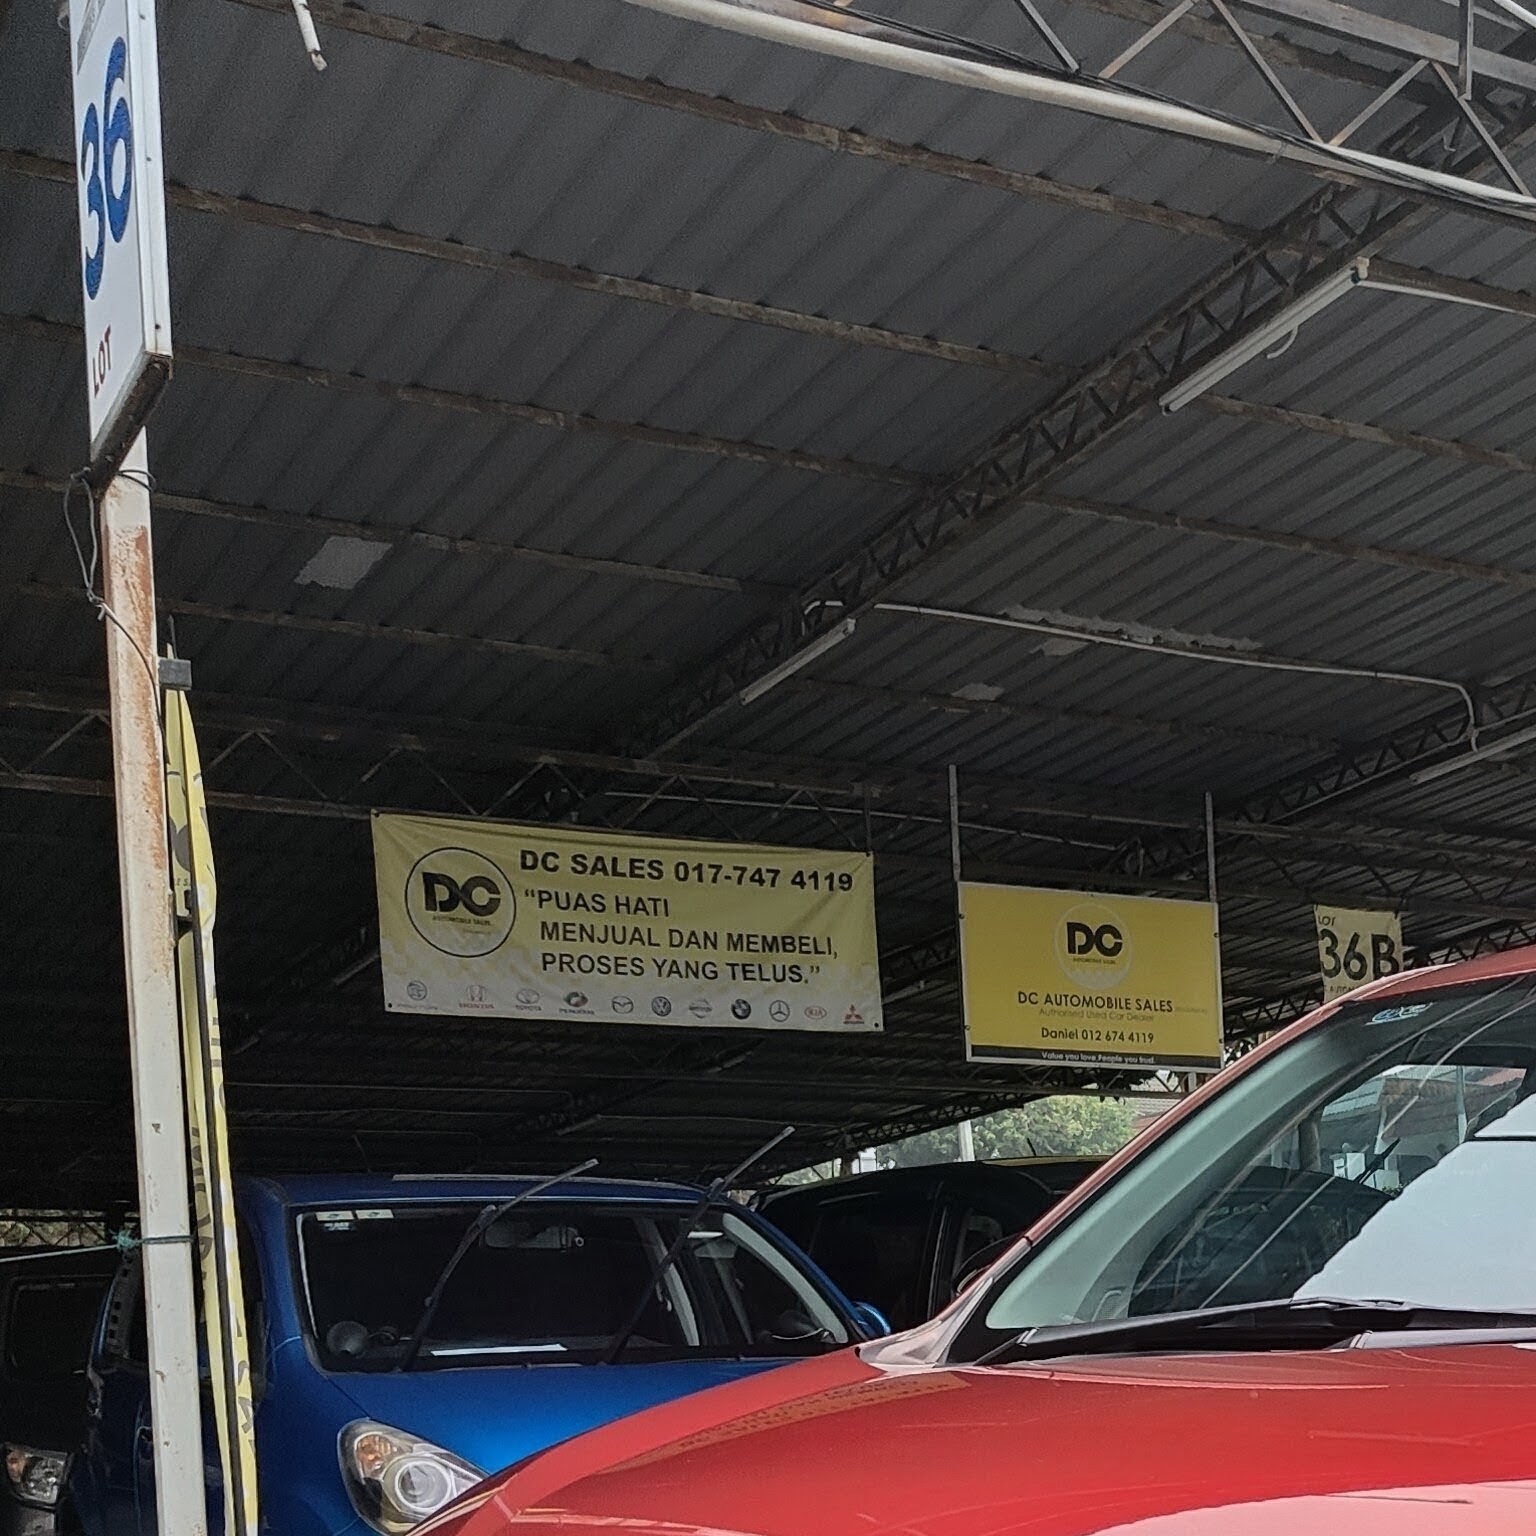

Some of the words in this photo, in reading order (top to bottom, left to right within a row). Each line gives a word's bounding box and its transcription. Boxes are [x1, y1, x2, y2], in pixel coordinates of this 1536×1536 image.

[81, 36, 133, 300] 36
[92, 325, 112, 399] LOT
[520, 850, 560, 873] DC
[570, 853, 664, 880] SALES
[674, 861, 781, 888] 017-747
[791, 870, 853, 891] 4119
[422, 871, 501, 917] DC
[615, 896, 670, 917] HATI
[540, 921, 660, 947] MENJUAL
[668, 928, 718, 950] DAN
[727, 932, 838, 959] MEMBELI,
[1066, 922, 1123, 957] DC
[1319, 928, 1400, 981] 36B
[541, 952, 645, 977] PROSES
[652, 958, 718, 980] YANG
[1018, 991, 1039, 1005] DC
[1044, 993, 1132, 1011] AUTOMOBILE
[1135, 999, 1173, 1013] SALES
[1041, 1027, 1079, 1040] Daniel
[1081, 1029, 1102, 1041] 012
[1105, 1030, 1125, 1042] 674
[1128, 1032, 1154, 1044] 4119
